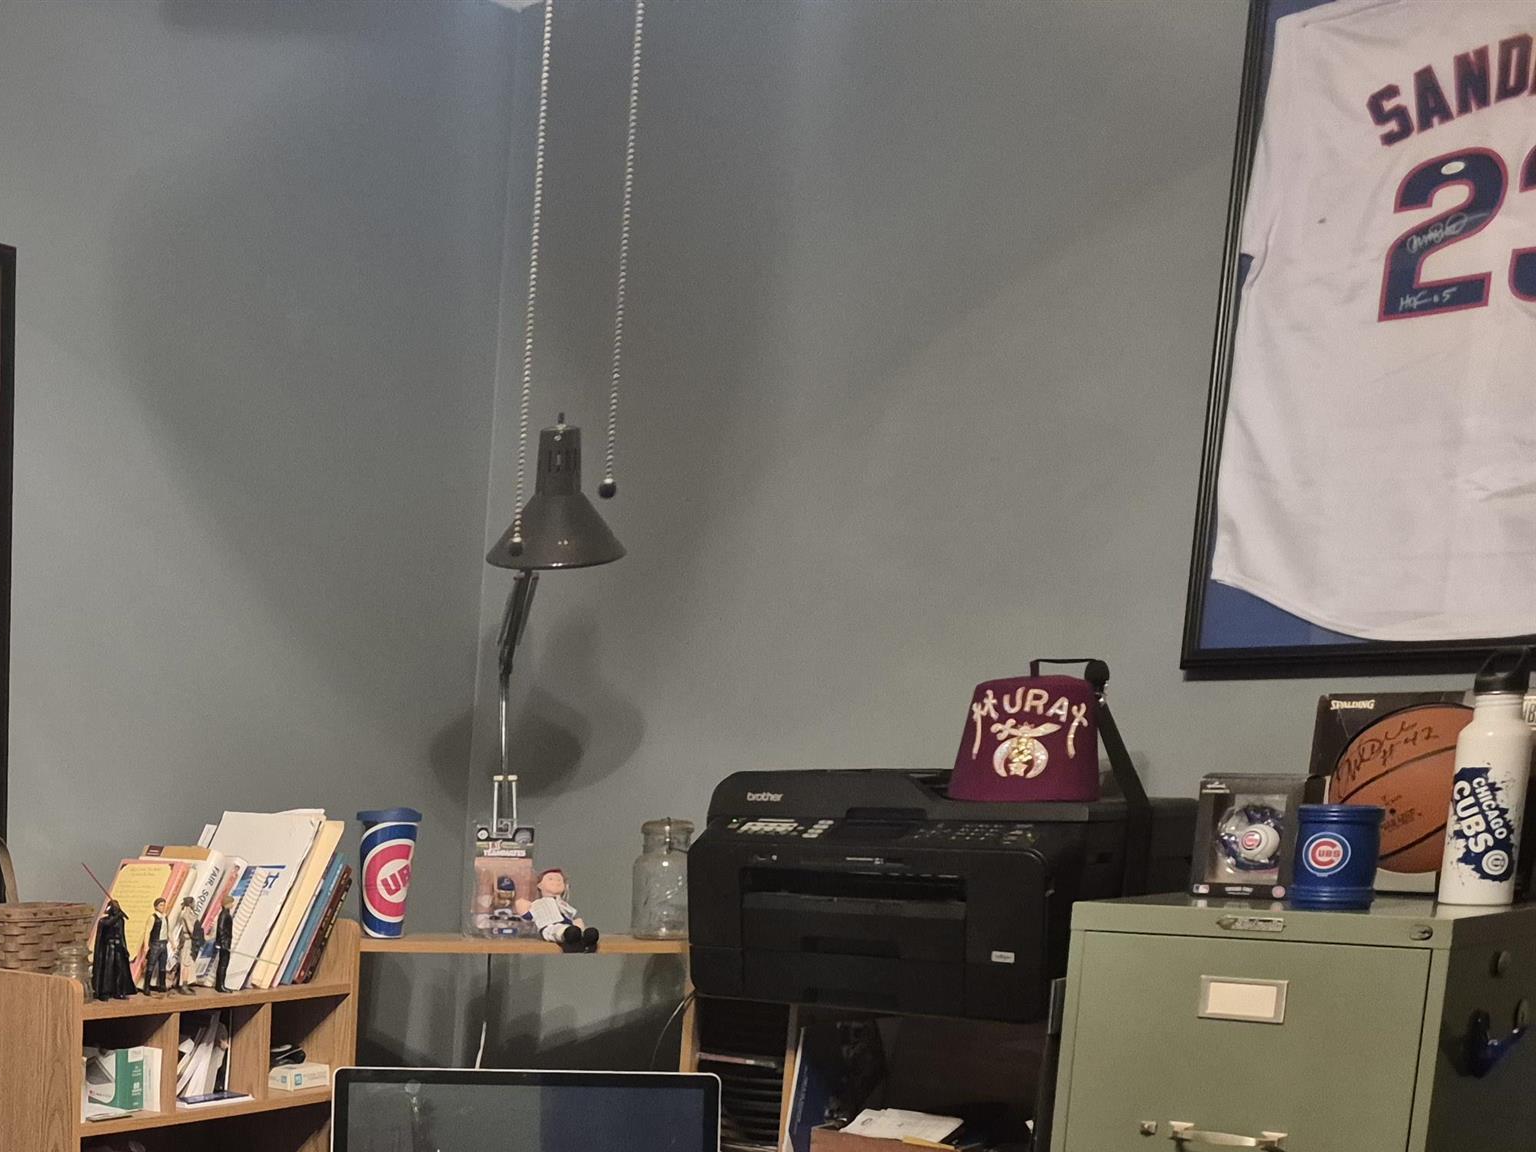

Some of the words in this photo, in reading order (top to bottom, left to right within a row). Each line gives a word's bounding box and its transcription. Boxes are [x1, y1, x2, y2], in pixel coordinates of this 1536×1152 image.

[1366, 33, 1536, 147] SAND
[1331, 699, 1375, 710] SPALDING
[747, 792, 784, 802] brother
[1454, 780, 1494, 853] CUBS
[1473, 777, 1507, 839] CHICAGO
